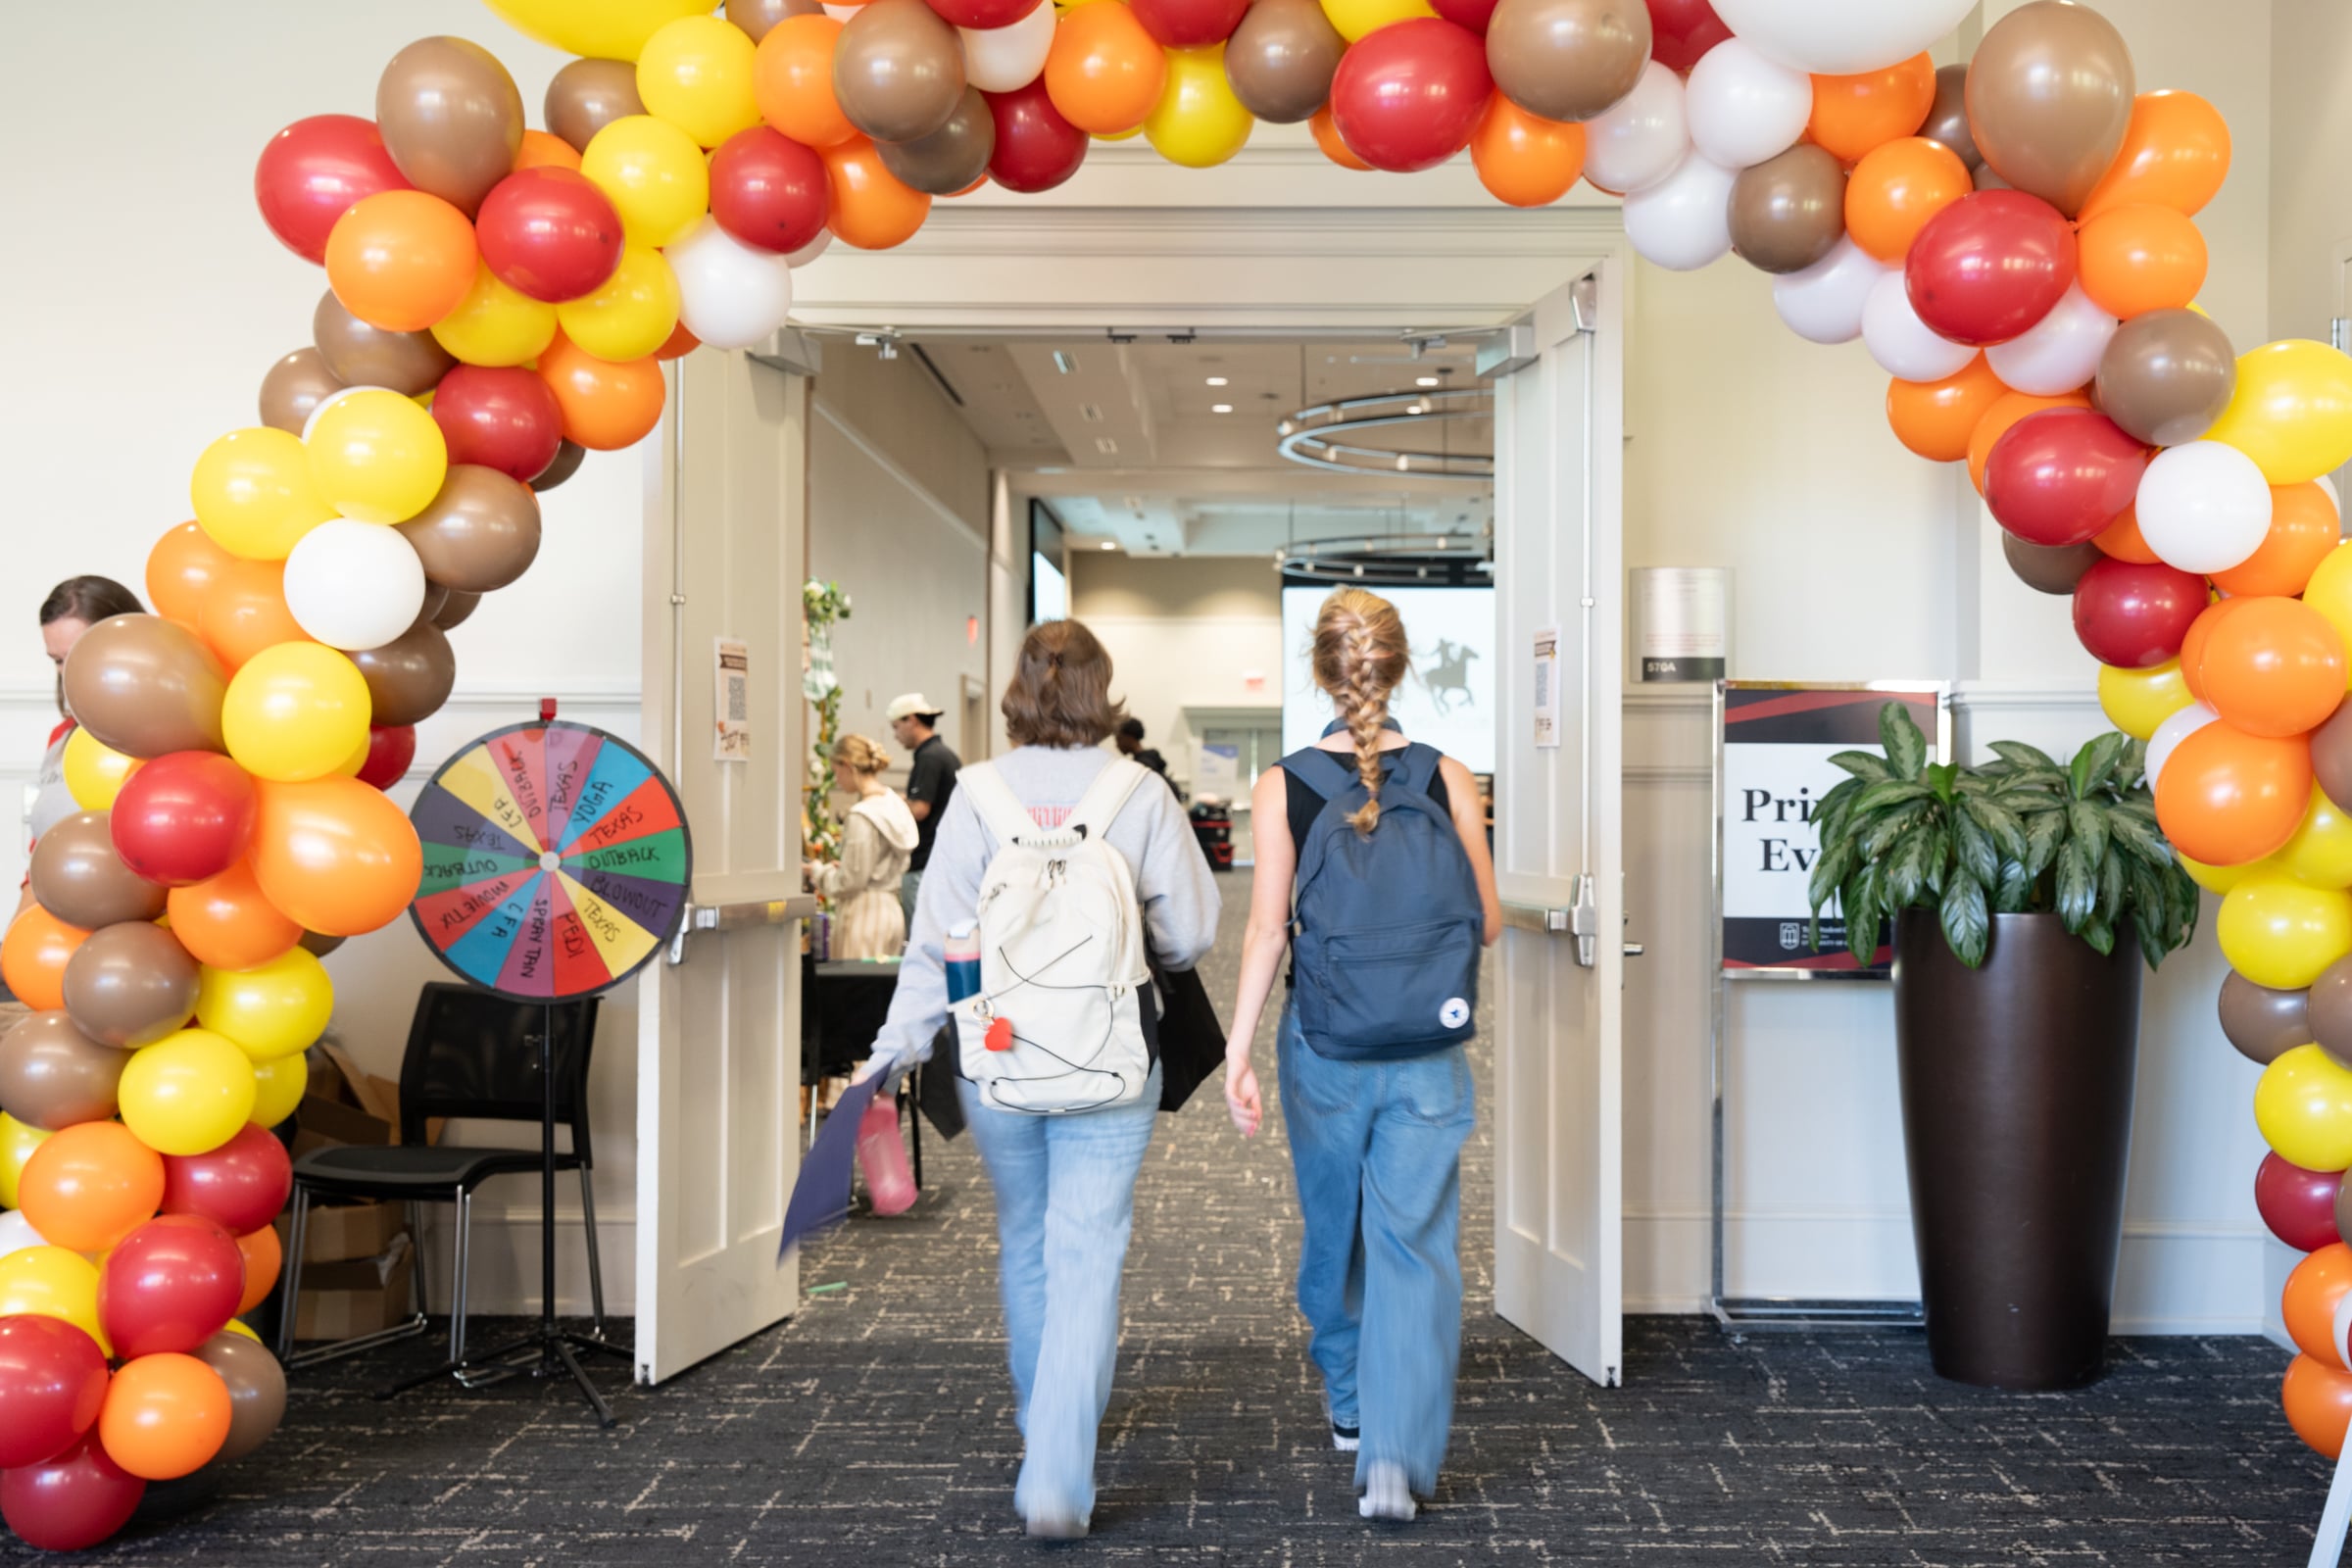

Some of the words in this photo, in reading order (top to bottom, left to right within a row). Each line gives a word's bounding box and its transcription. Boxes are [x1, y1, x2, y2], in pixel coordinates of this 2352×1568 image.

[548, 760, 578, 813] TEXAS
[572, 781, 614, 824] YOGA
[1740, 787, 1821, 823] Pri
[453, 825, 506, 852] TEXAS
[589, 805, 644, 846] TEXAS
[423, 858, 498, 879] OUTBACK
[588, 846, 661, 871] OUTBACK
[1758, 838, 1818, 872] Ev
[590, 874, 668, 918] BLOWOUT
[529, 899, 548, 943] SPRAY
[557, 910, 586, 959] PEDI
[583, 898, 621, 944] TEXAS
[520, 947, 542, 979] TAN
